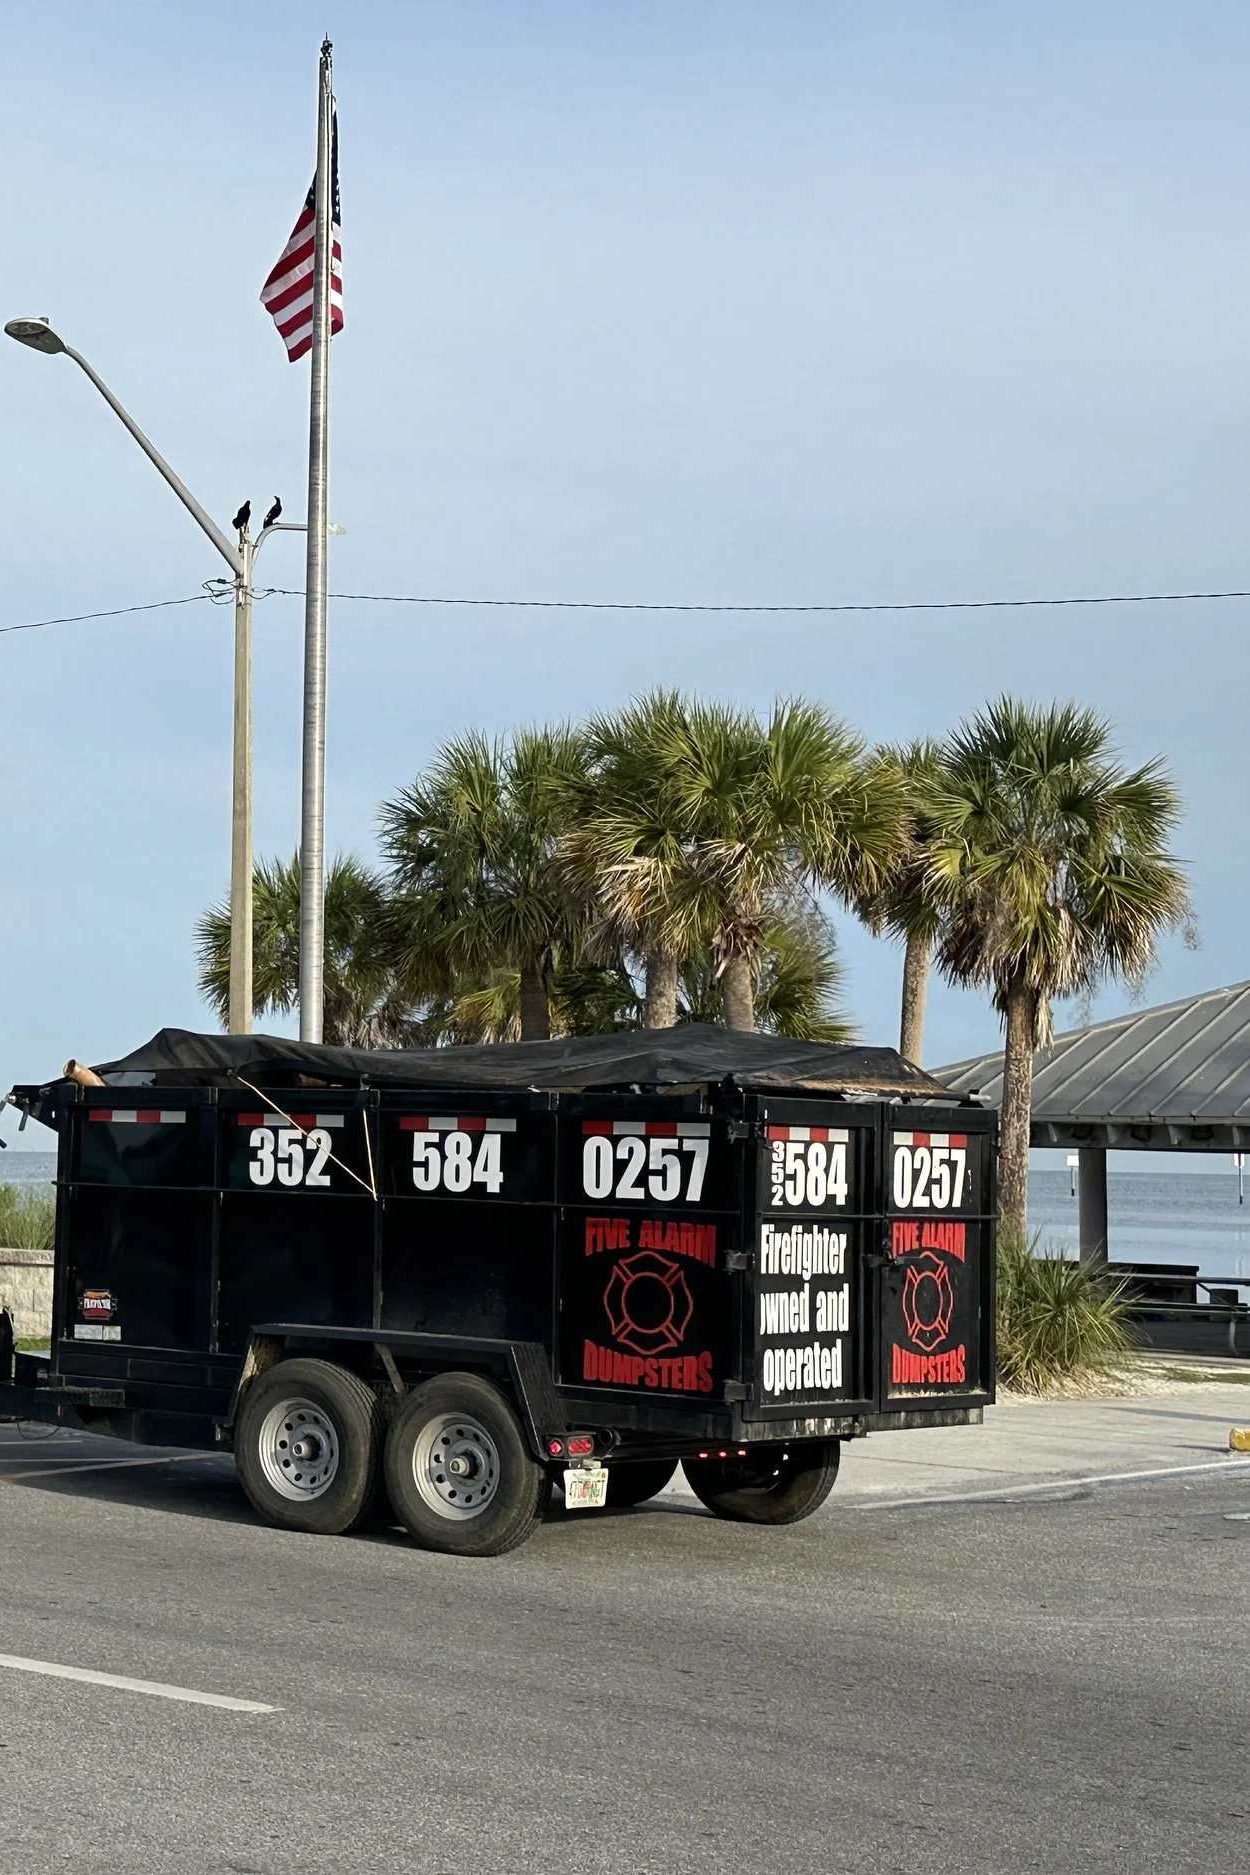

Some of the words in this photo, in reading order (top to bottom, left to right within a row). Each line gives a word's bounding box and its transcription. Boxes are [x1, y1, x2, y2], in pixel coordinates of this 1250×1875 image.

[250, 1128, 332, 1186] 352
[413, 1132, 503, 1193] 584
[583, 1136, 709, 1201] 0257
[785, 1142, 848, 1206] 584
[894, 1147, 966, 1208] 0257
[585, 1217, 630, 1256] FIVE
[639, 1220, 717, 1268] ALARM
[761, 1224, 847, 1281] Firefighter
[893, 1222, 920, 1259] FIVE
[922, 1222, 966, 1264] ALARM
[816, 1283, 850, 1332] and
[584, 1339, 713, 1393] DUMPSTERS
[763, 1338, 843, 1396] operated
[893, 1343, 966, 1383] DUMPSTERS
